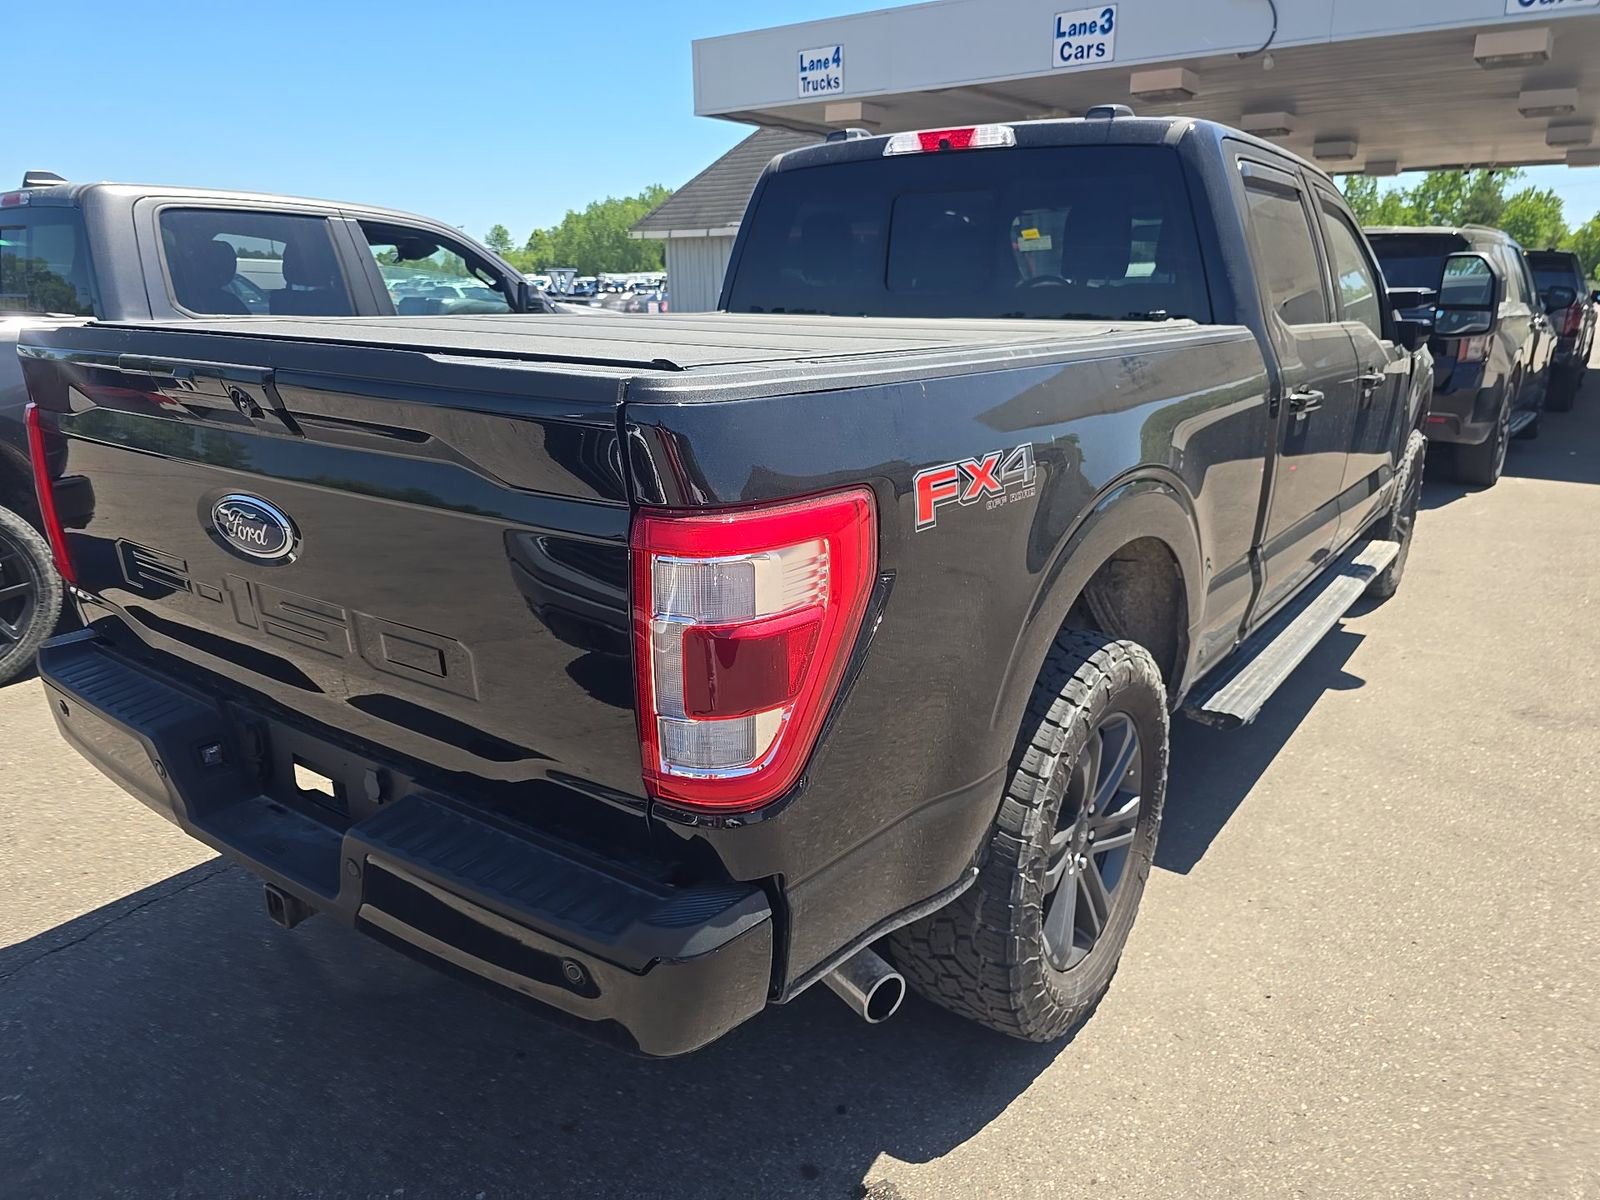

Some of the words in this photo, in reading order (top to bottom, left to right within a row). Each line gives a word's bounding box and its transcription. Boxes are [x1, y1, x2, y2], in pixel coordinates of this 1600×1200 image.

[1060, 41, 1106, 62] Cars
[801, 74, 840, 93] Trucks
[912, 442, 1036, 533] FX4
[219, 507, 268, 545] Ford
[114, 537, 480, 701] F-150
